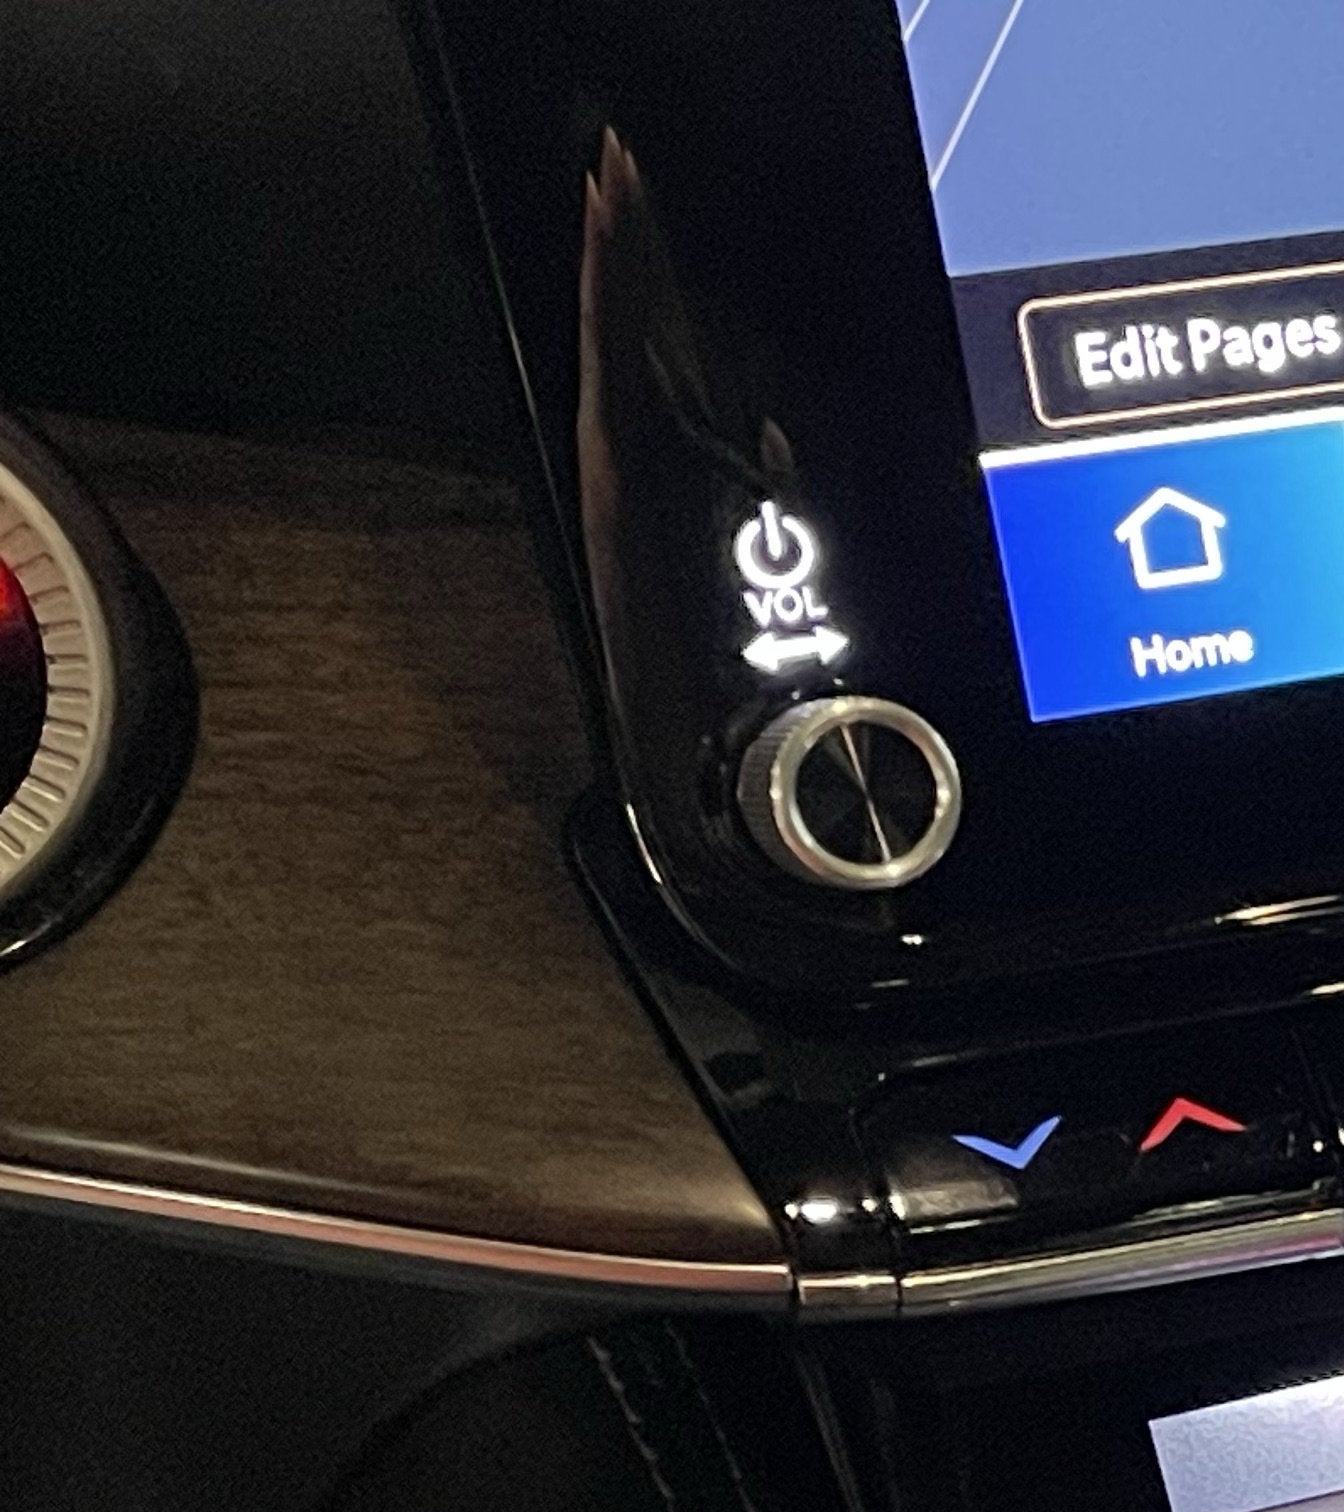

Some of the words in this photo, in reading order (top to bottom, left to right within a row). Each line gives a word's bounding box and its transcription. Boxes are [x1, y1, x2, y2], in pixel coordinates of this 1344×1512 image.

[1074, 326, 1183, 388] Edit
[1188, 312, 1342, 374] Pages
[743, 586, 828, 627] VOL
[1130, 625, 1254, 678] Home
